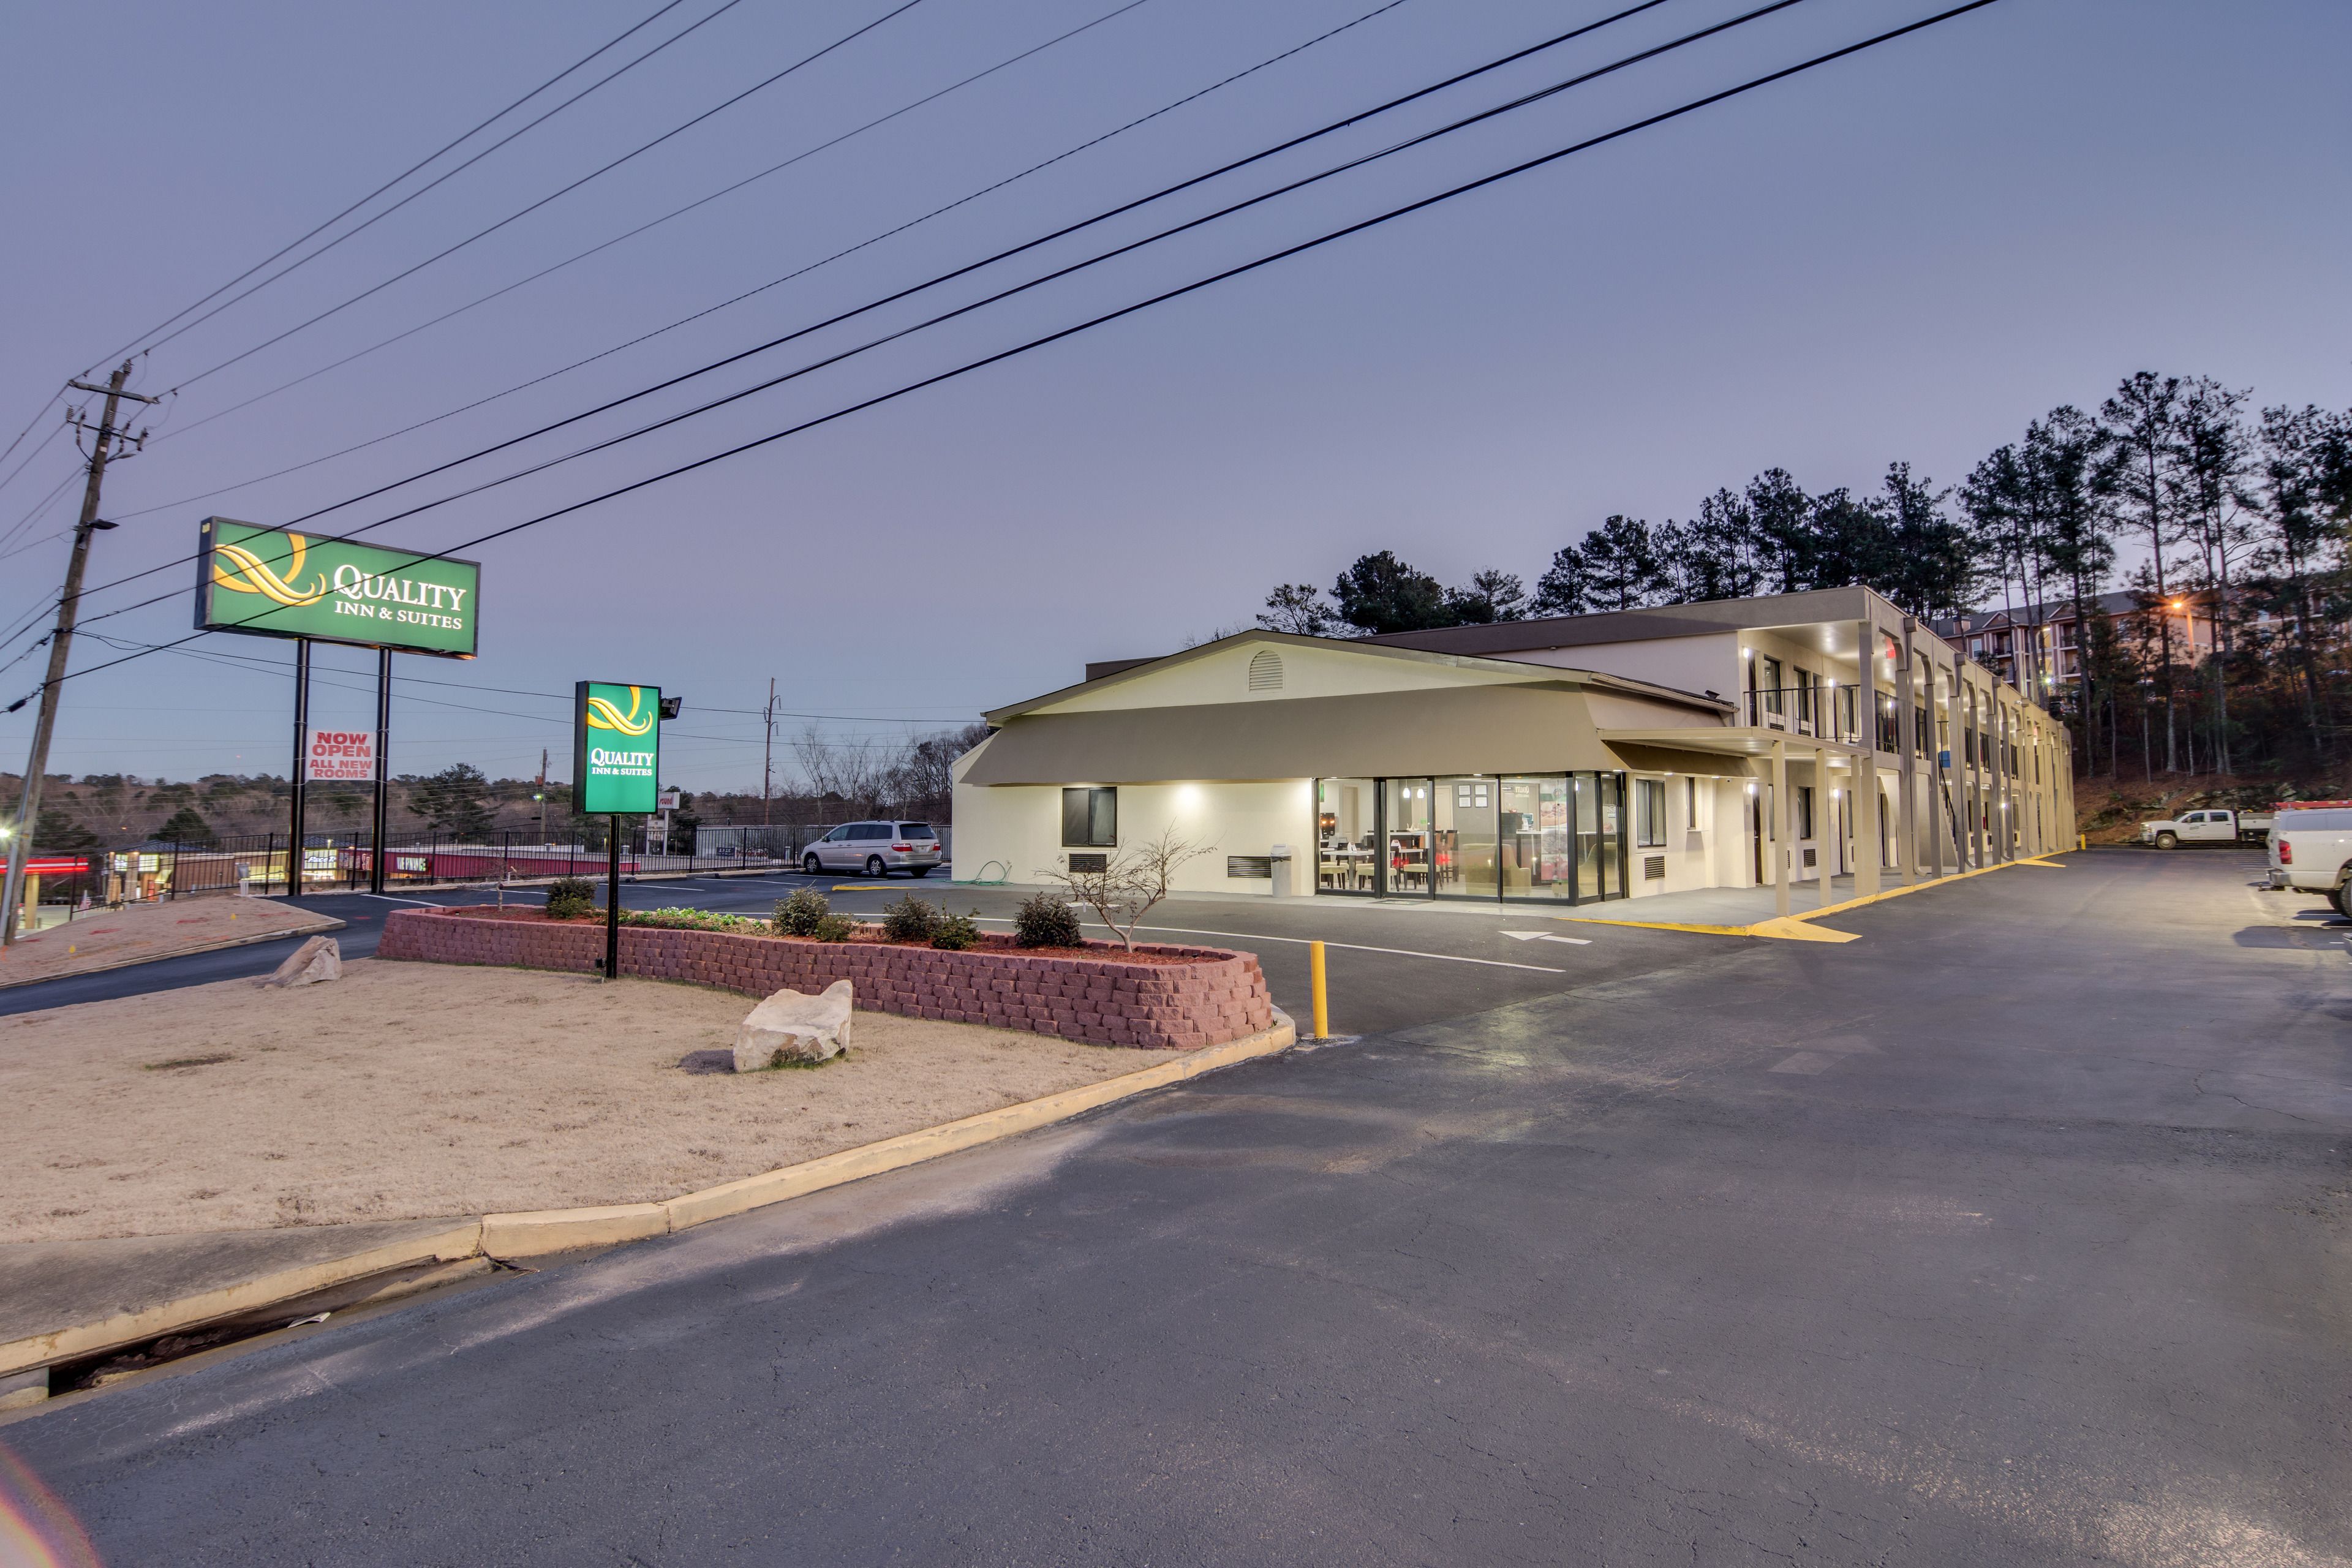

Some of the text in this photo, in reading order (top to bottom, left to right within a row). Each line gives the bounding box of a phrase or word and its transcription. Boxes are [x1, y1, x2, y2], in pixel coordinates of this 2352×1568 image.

[334, 564, 467, 611] QUALITY
[334, 600, 462, 630] INN & SUITES
[317, 733, 368, 745] NOW
[312, 744, 371, 757] OPEN
[591, 748, 654, 766] QUALITY
[309, 760, 372, 769] ALL NEW
[314, 769, 368, 778] ROOMS
